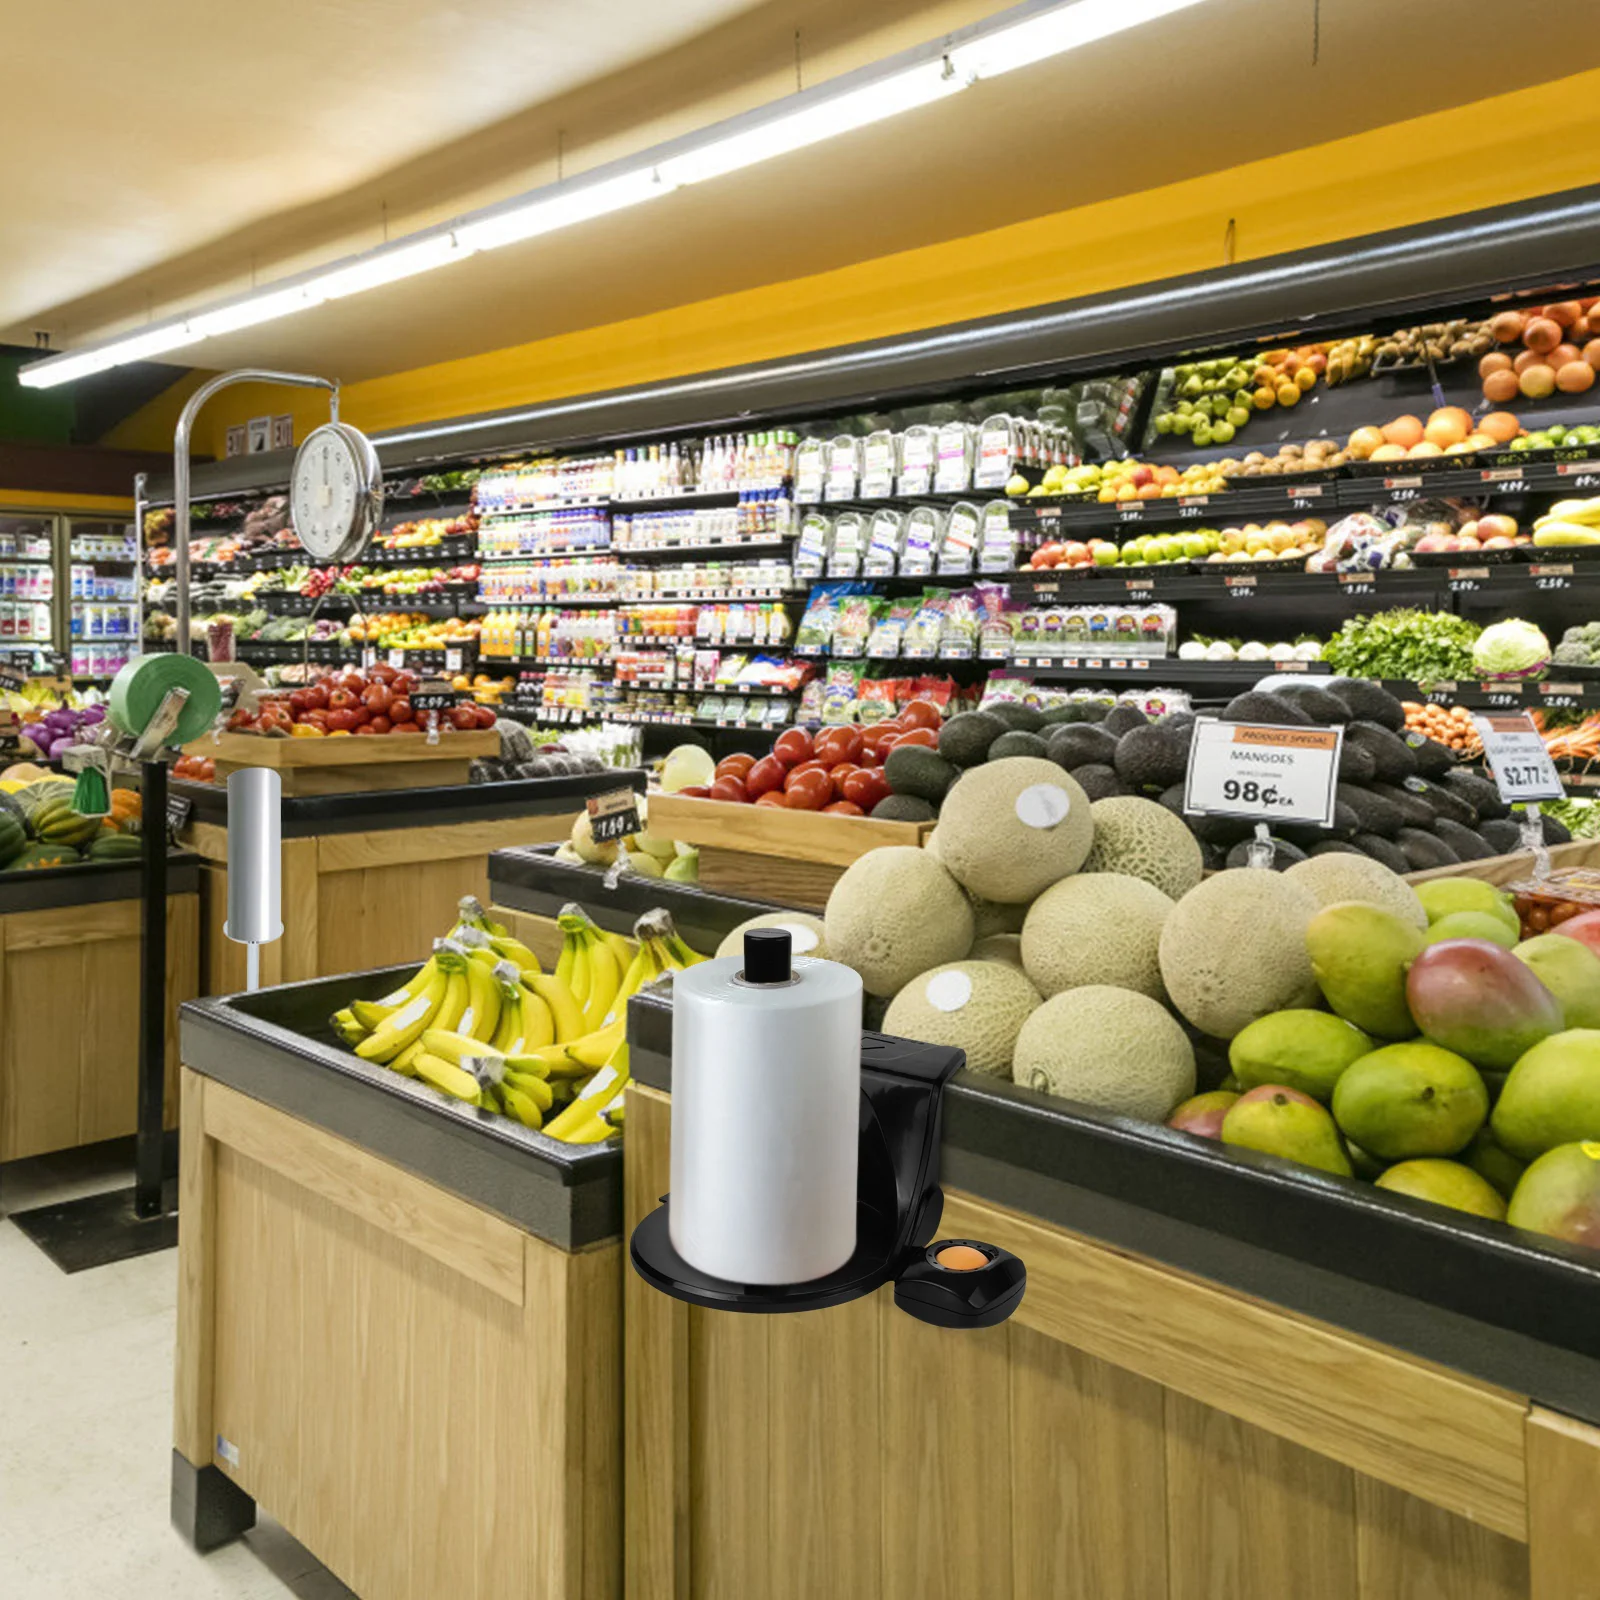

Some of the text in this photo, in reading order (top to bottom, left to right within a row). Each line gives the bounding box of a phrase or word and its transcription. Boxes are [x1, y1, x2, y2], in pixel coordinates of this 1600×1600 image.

[1242, 730, 1327, 744] PRODUCE SPECIAL
[1230, 750, 1295, 766] MANGOES
[1503, 765, 1540, 786] $2.77
